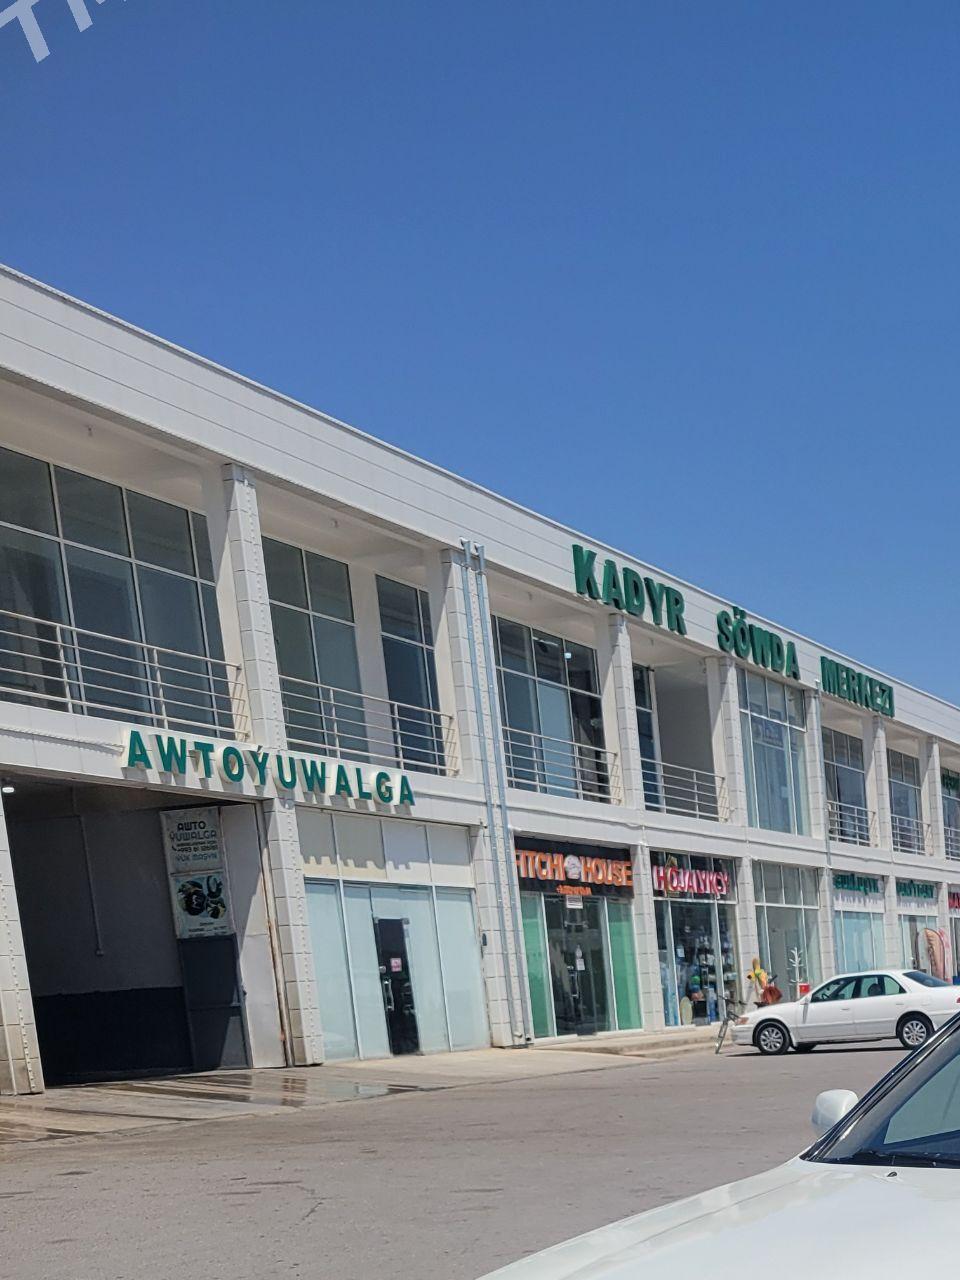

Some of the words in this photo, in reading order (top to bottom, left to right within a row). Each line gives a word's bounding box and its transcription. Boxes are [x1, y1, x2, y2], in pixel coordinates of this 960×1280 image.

[573, 544, 688, 635] KADYR
[716, 606, 801, 681] SÖWDA
[820, 656, 895, 718] MERKEZI
[127, 730, 416, 806] AWTOÝUWALGA
[579, 856, 633, 887] HOUSE
